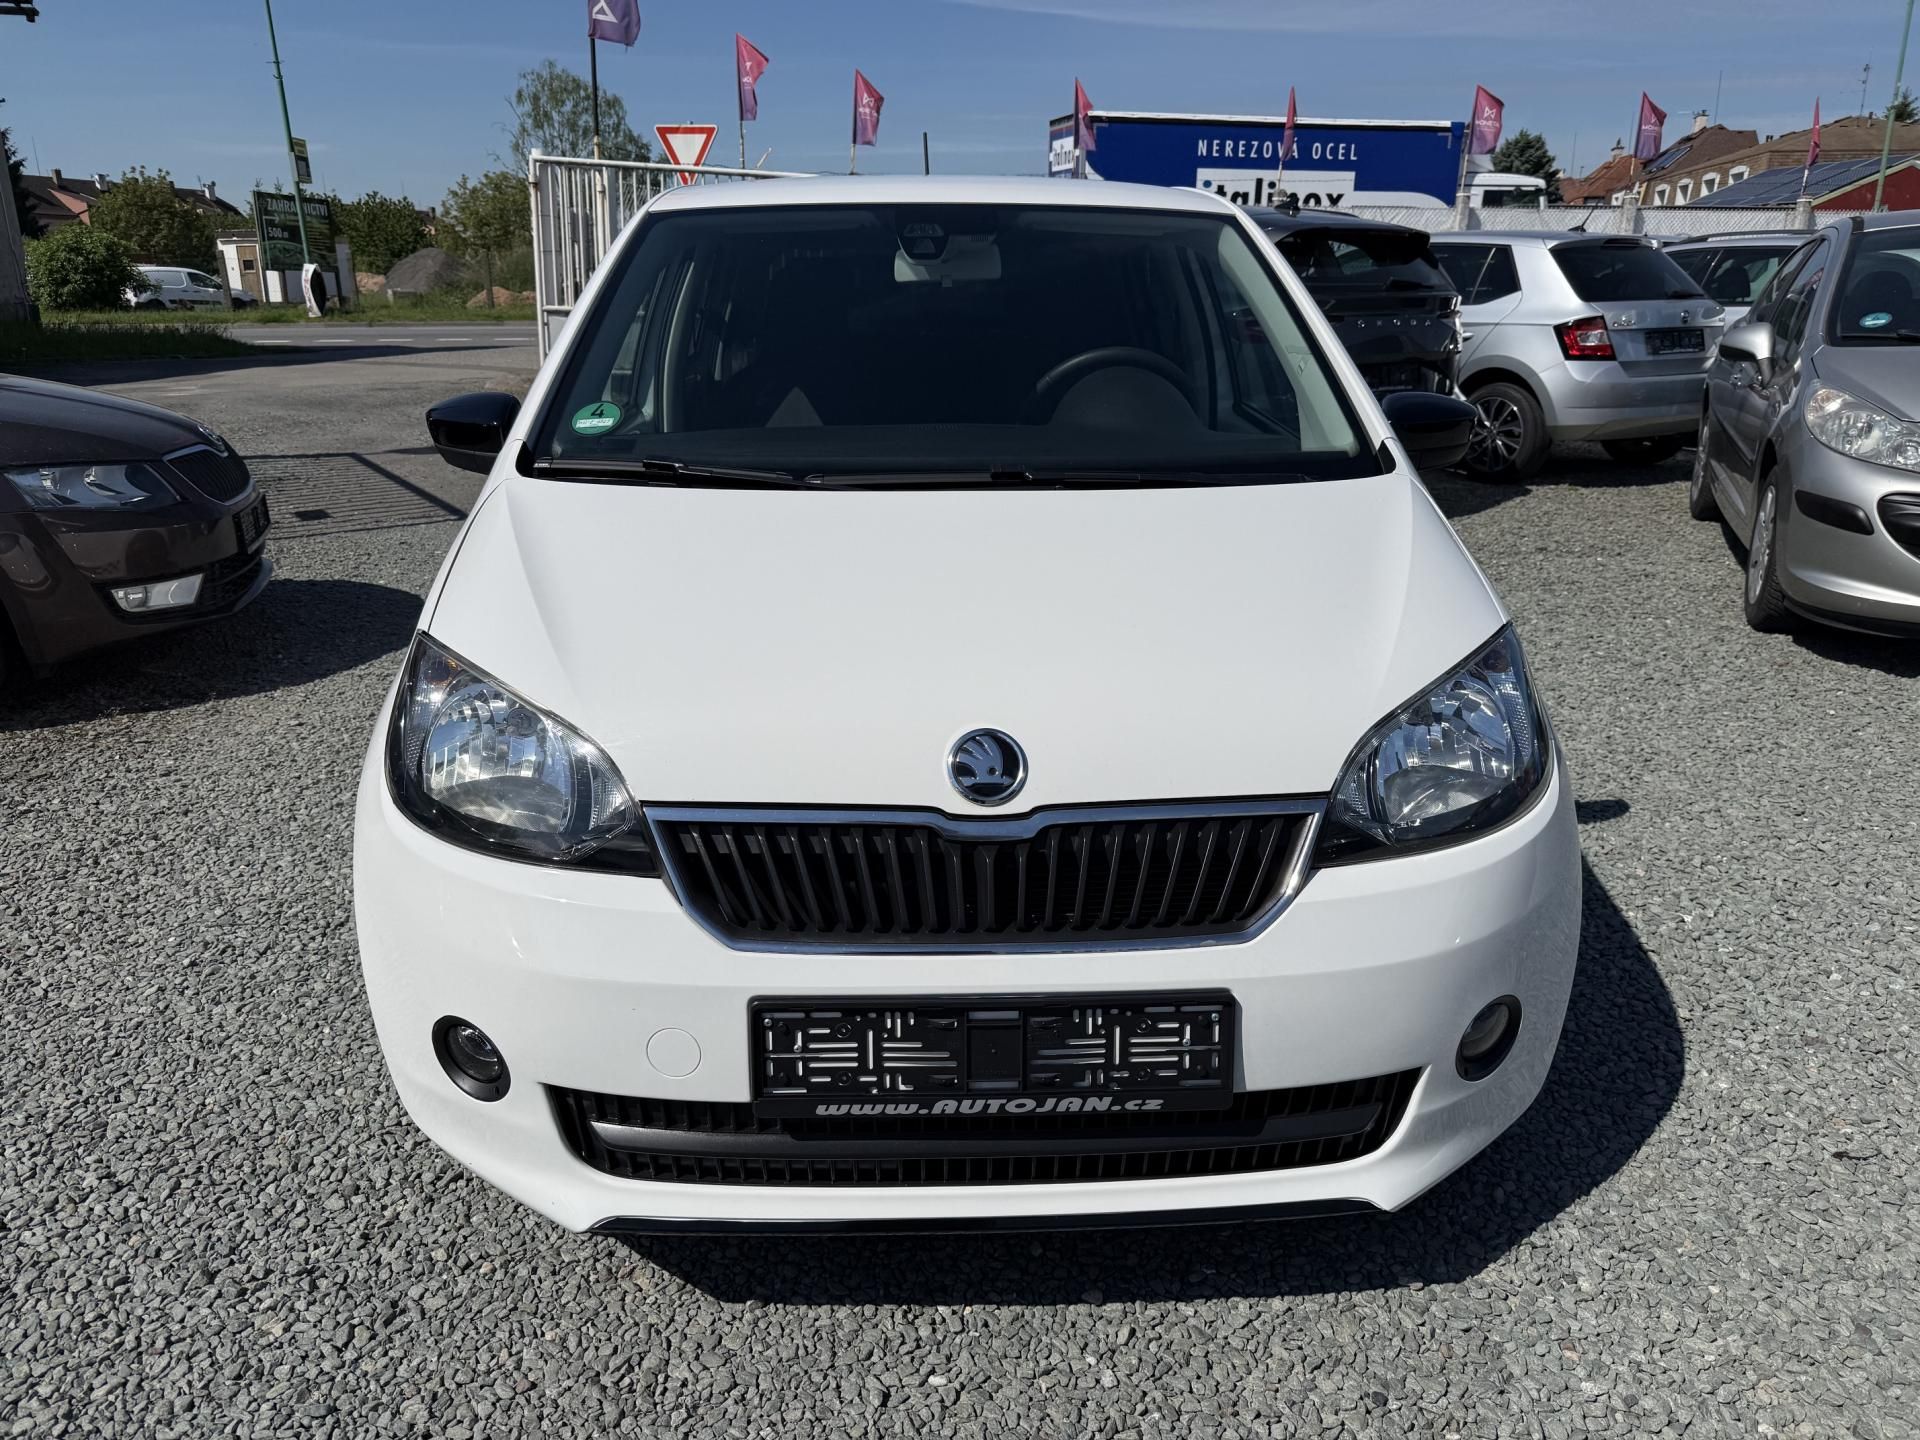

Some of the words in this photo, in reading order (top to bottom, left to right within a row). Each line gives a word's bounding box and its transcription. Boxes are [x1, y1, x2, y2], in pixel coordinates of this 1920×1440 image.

[1197, 137, 1299, 160] NEREZOVÁ
[1311, 142, 1358, 161] OCEL
[1202, 178, 1345, 207] aliox
[266, 198, 328, 217] ZAHRANICTVÍ
[268, 226, 282, 238] 500
[283, 230, 289, 238] m
[591, 403, 604, 418] 4
[815, 1096, 1165, 1116] www.AUTOJAN.cz
